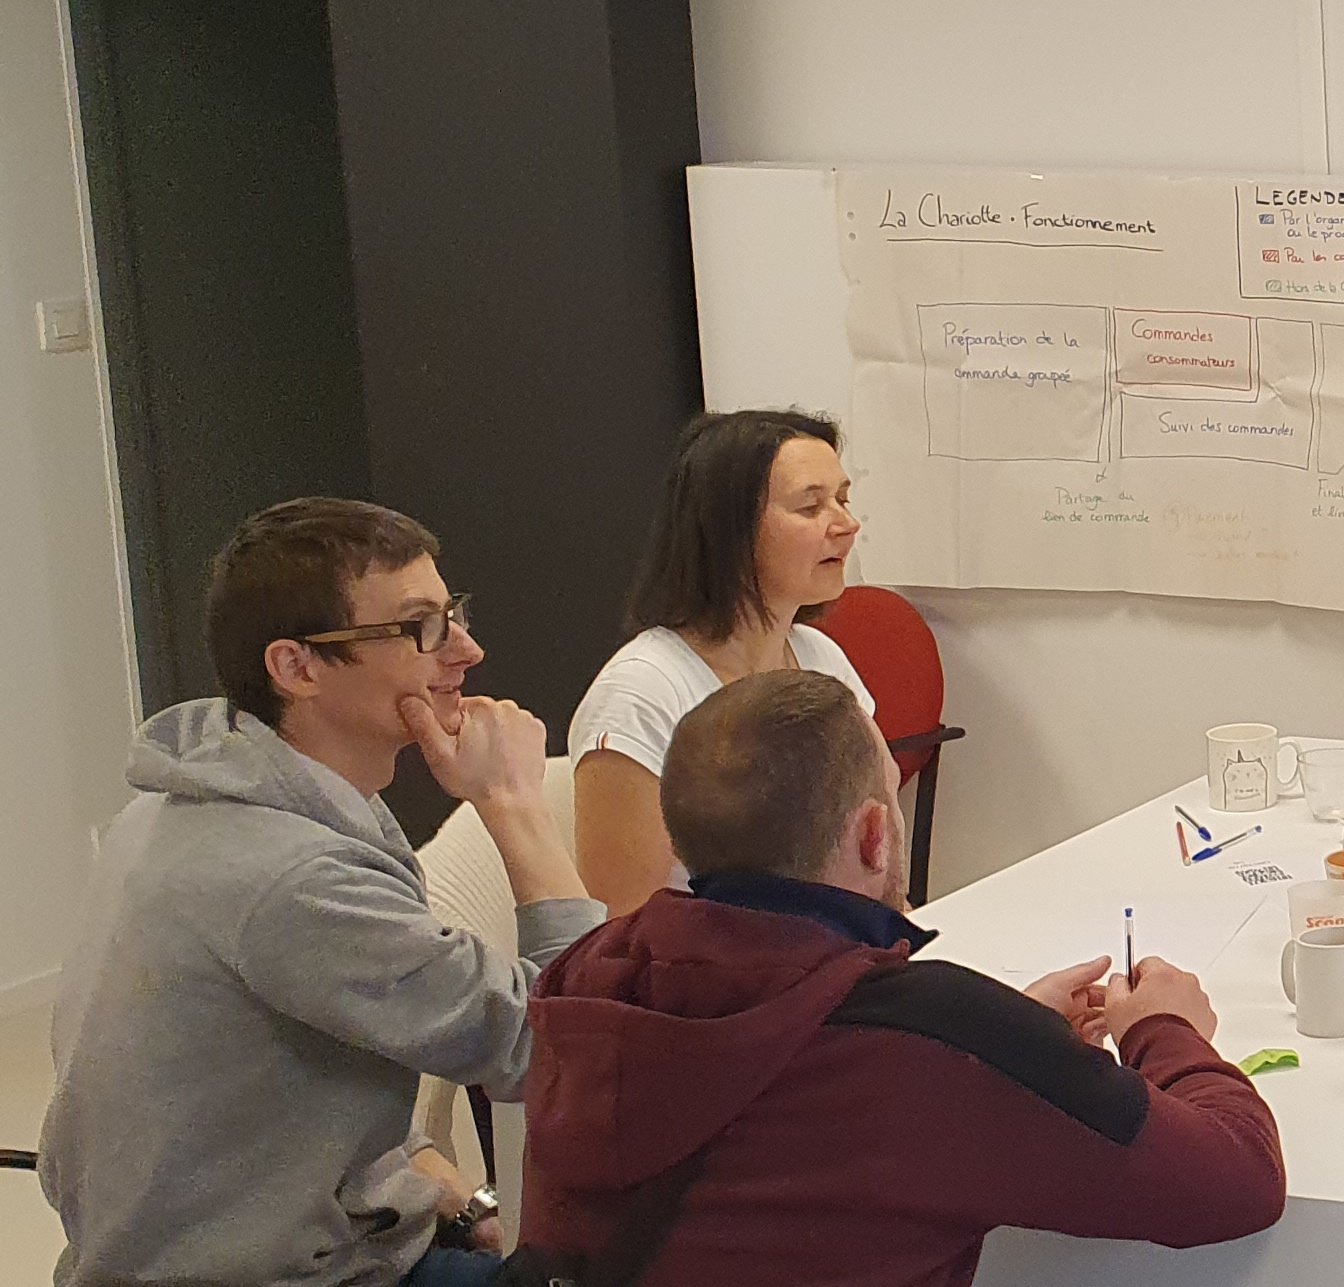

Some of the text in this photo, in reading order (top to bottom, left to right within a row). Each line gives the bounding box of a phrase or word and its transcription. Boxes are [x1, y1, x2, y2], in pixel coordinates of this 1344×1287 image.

[880, 189, 1156, 234] La Chariotte Fonctionnement
[1280, 209, 1301, 225] Par
[1308, 226, 1318, 238] le
[942, 321, 1080, 355] Préparation de la
[1131, 318, 1214, 343] Commandes
[1146, 351, 1236, 368] consommateurs
[1158, 411, 1295, 437] Suivi des commandes
[1055, 487, 1107, 511] Partage
[1069, 510, 1083, 522] de
[1090, 510, 1151, 523] commande
[1312, 505, 1322, 517] et
